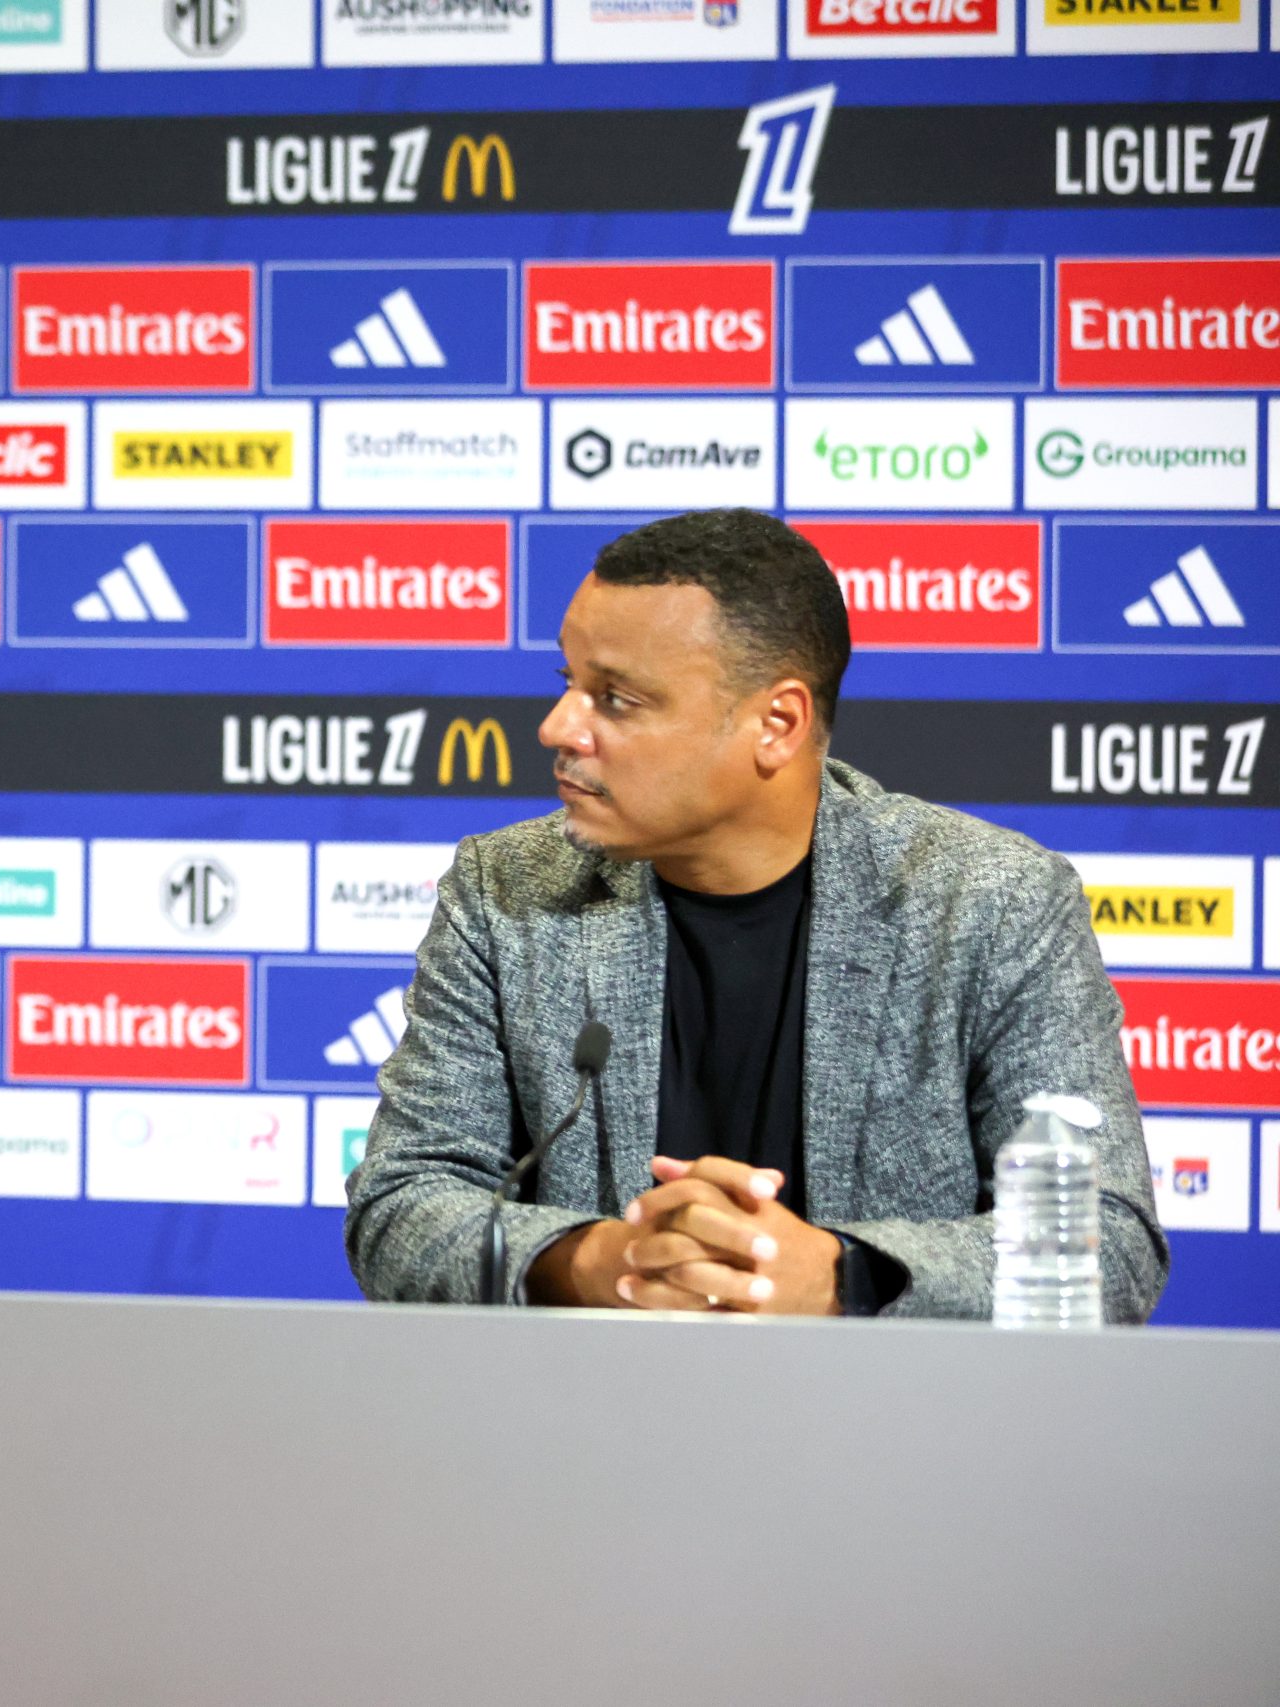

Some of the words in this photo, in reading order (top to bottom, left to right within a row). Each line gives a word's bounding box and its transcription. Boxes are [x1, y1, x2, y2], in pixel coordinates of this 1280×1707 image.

[819, 0, 983, 24] Betclic
[226, 134, 378, 204] LIGUE
[1054, 124, 1214, 195] LIGUE
[22, 302, 246, 357] Emirates
[534, 298, 767, 354] Emirates
[1068, 295, 1280, 351] Emirate
[122, 441, 281, 469] STANLEY
[344, 431, 519, 457] Staffmatch
[625, 439, 762, 469] ComAve
[1091, 441, 1247, 471] Groupama
[274, 555, 502, 610] Emirates
[833, 556, 1032, 612] mirates
[222, 714, 374, 786] LIGUE
[1050, 723, 1210, 795] LIGUE
[167, 863, 235, 929] MG
[331, 879, 438, 906] AUSHO
[1090, 896, 1221, 926] ANLEY
[17, 994, 242, 1050] Emirates
[1118, 1014, 1280, 1072] mirate
